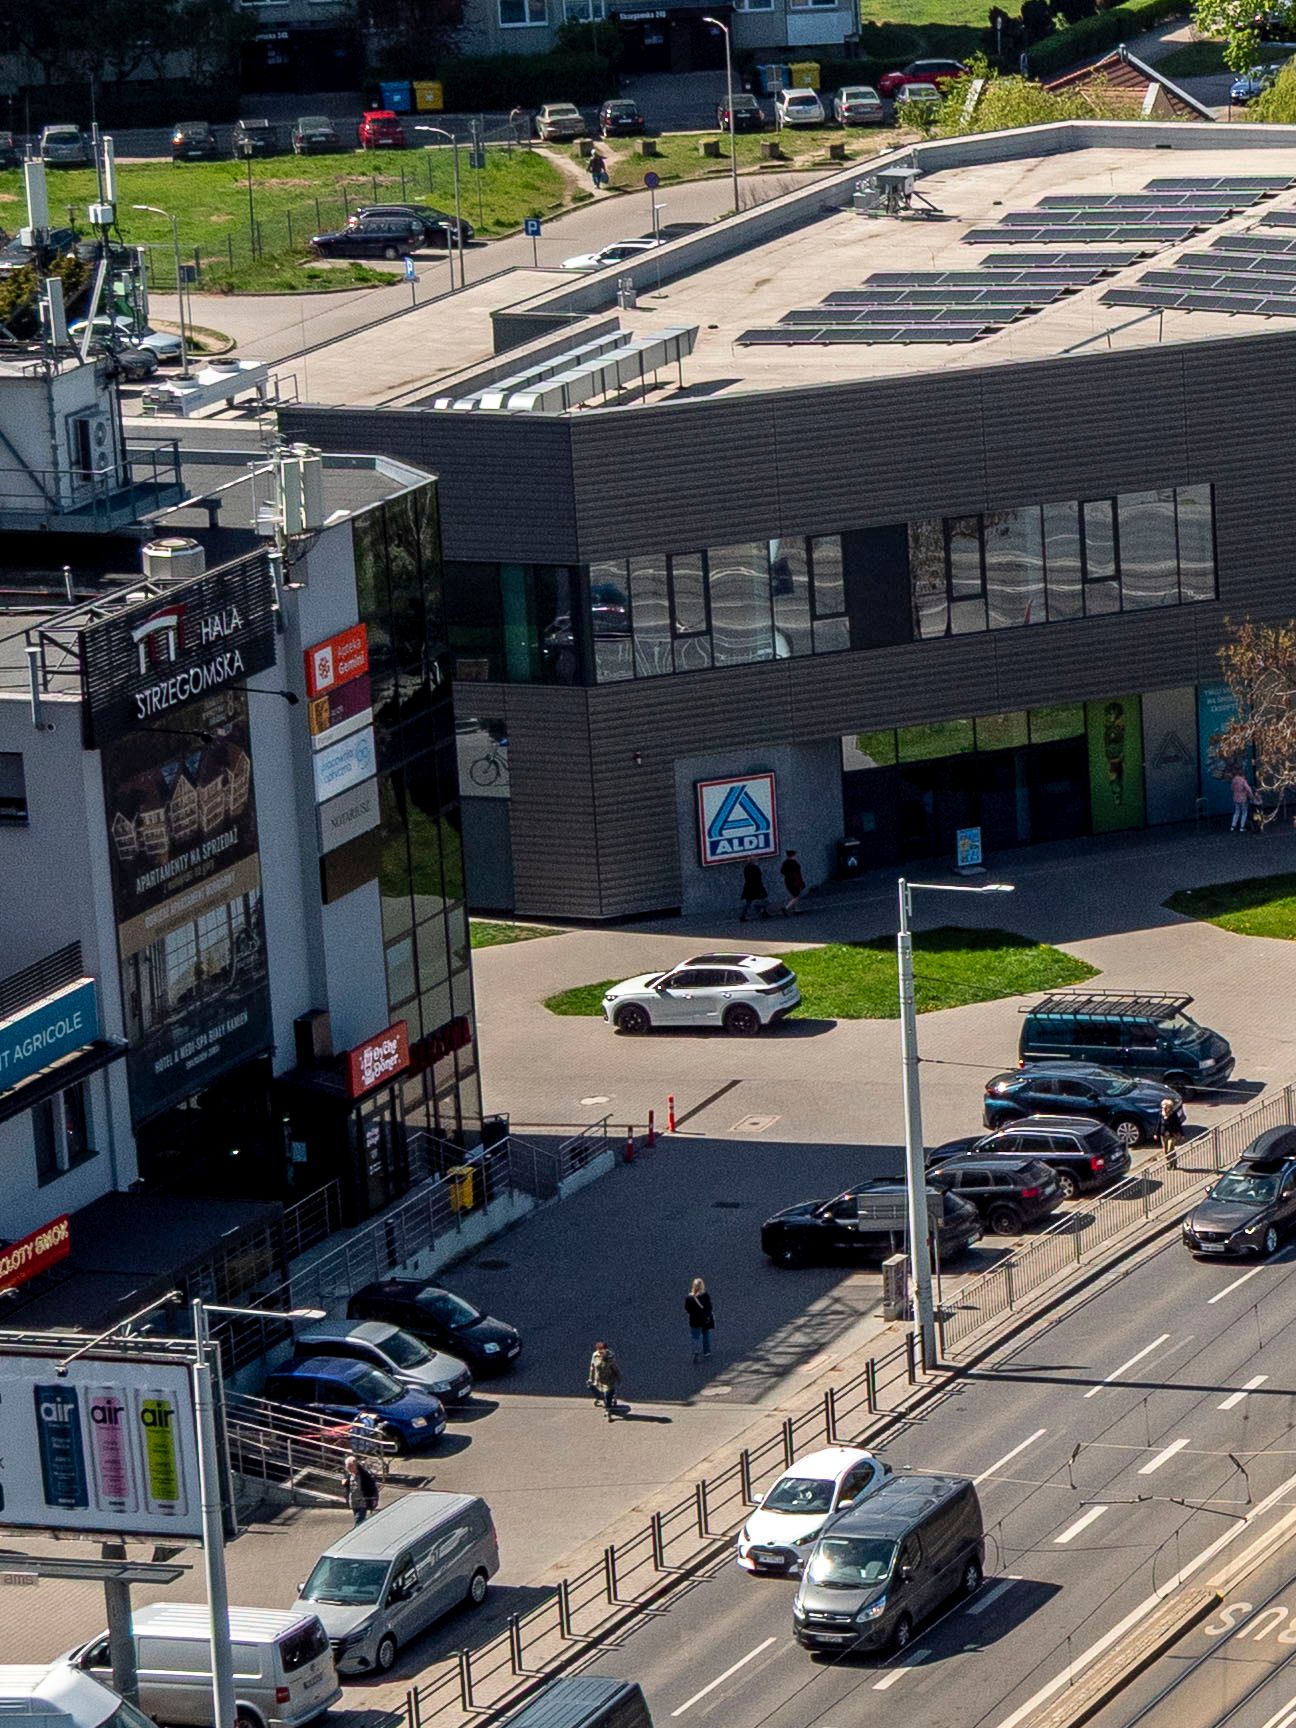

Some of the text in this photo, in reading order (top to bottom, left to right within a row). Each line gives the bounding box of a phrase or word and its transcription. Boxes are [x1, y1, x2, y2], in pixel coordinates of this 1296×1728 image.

[200, 607, 244, 645] HALA
[134, 649, 245, 720] STRZEGOMSKA
[715, 834, 766, 855] ALDI
[13, 1011, 83, 1064] AGRICOLE
[40, 1397, 75, 1423] air
[91, 1399, 124, 1425] air
[141, 1403, 175, 1428] air
[3, 1573, 35, 1586] ams
